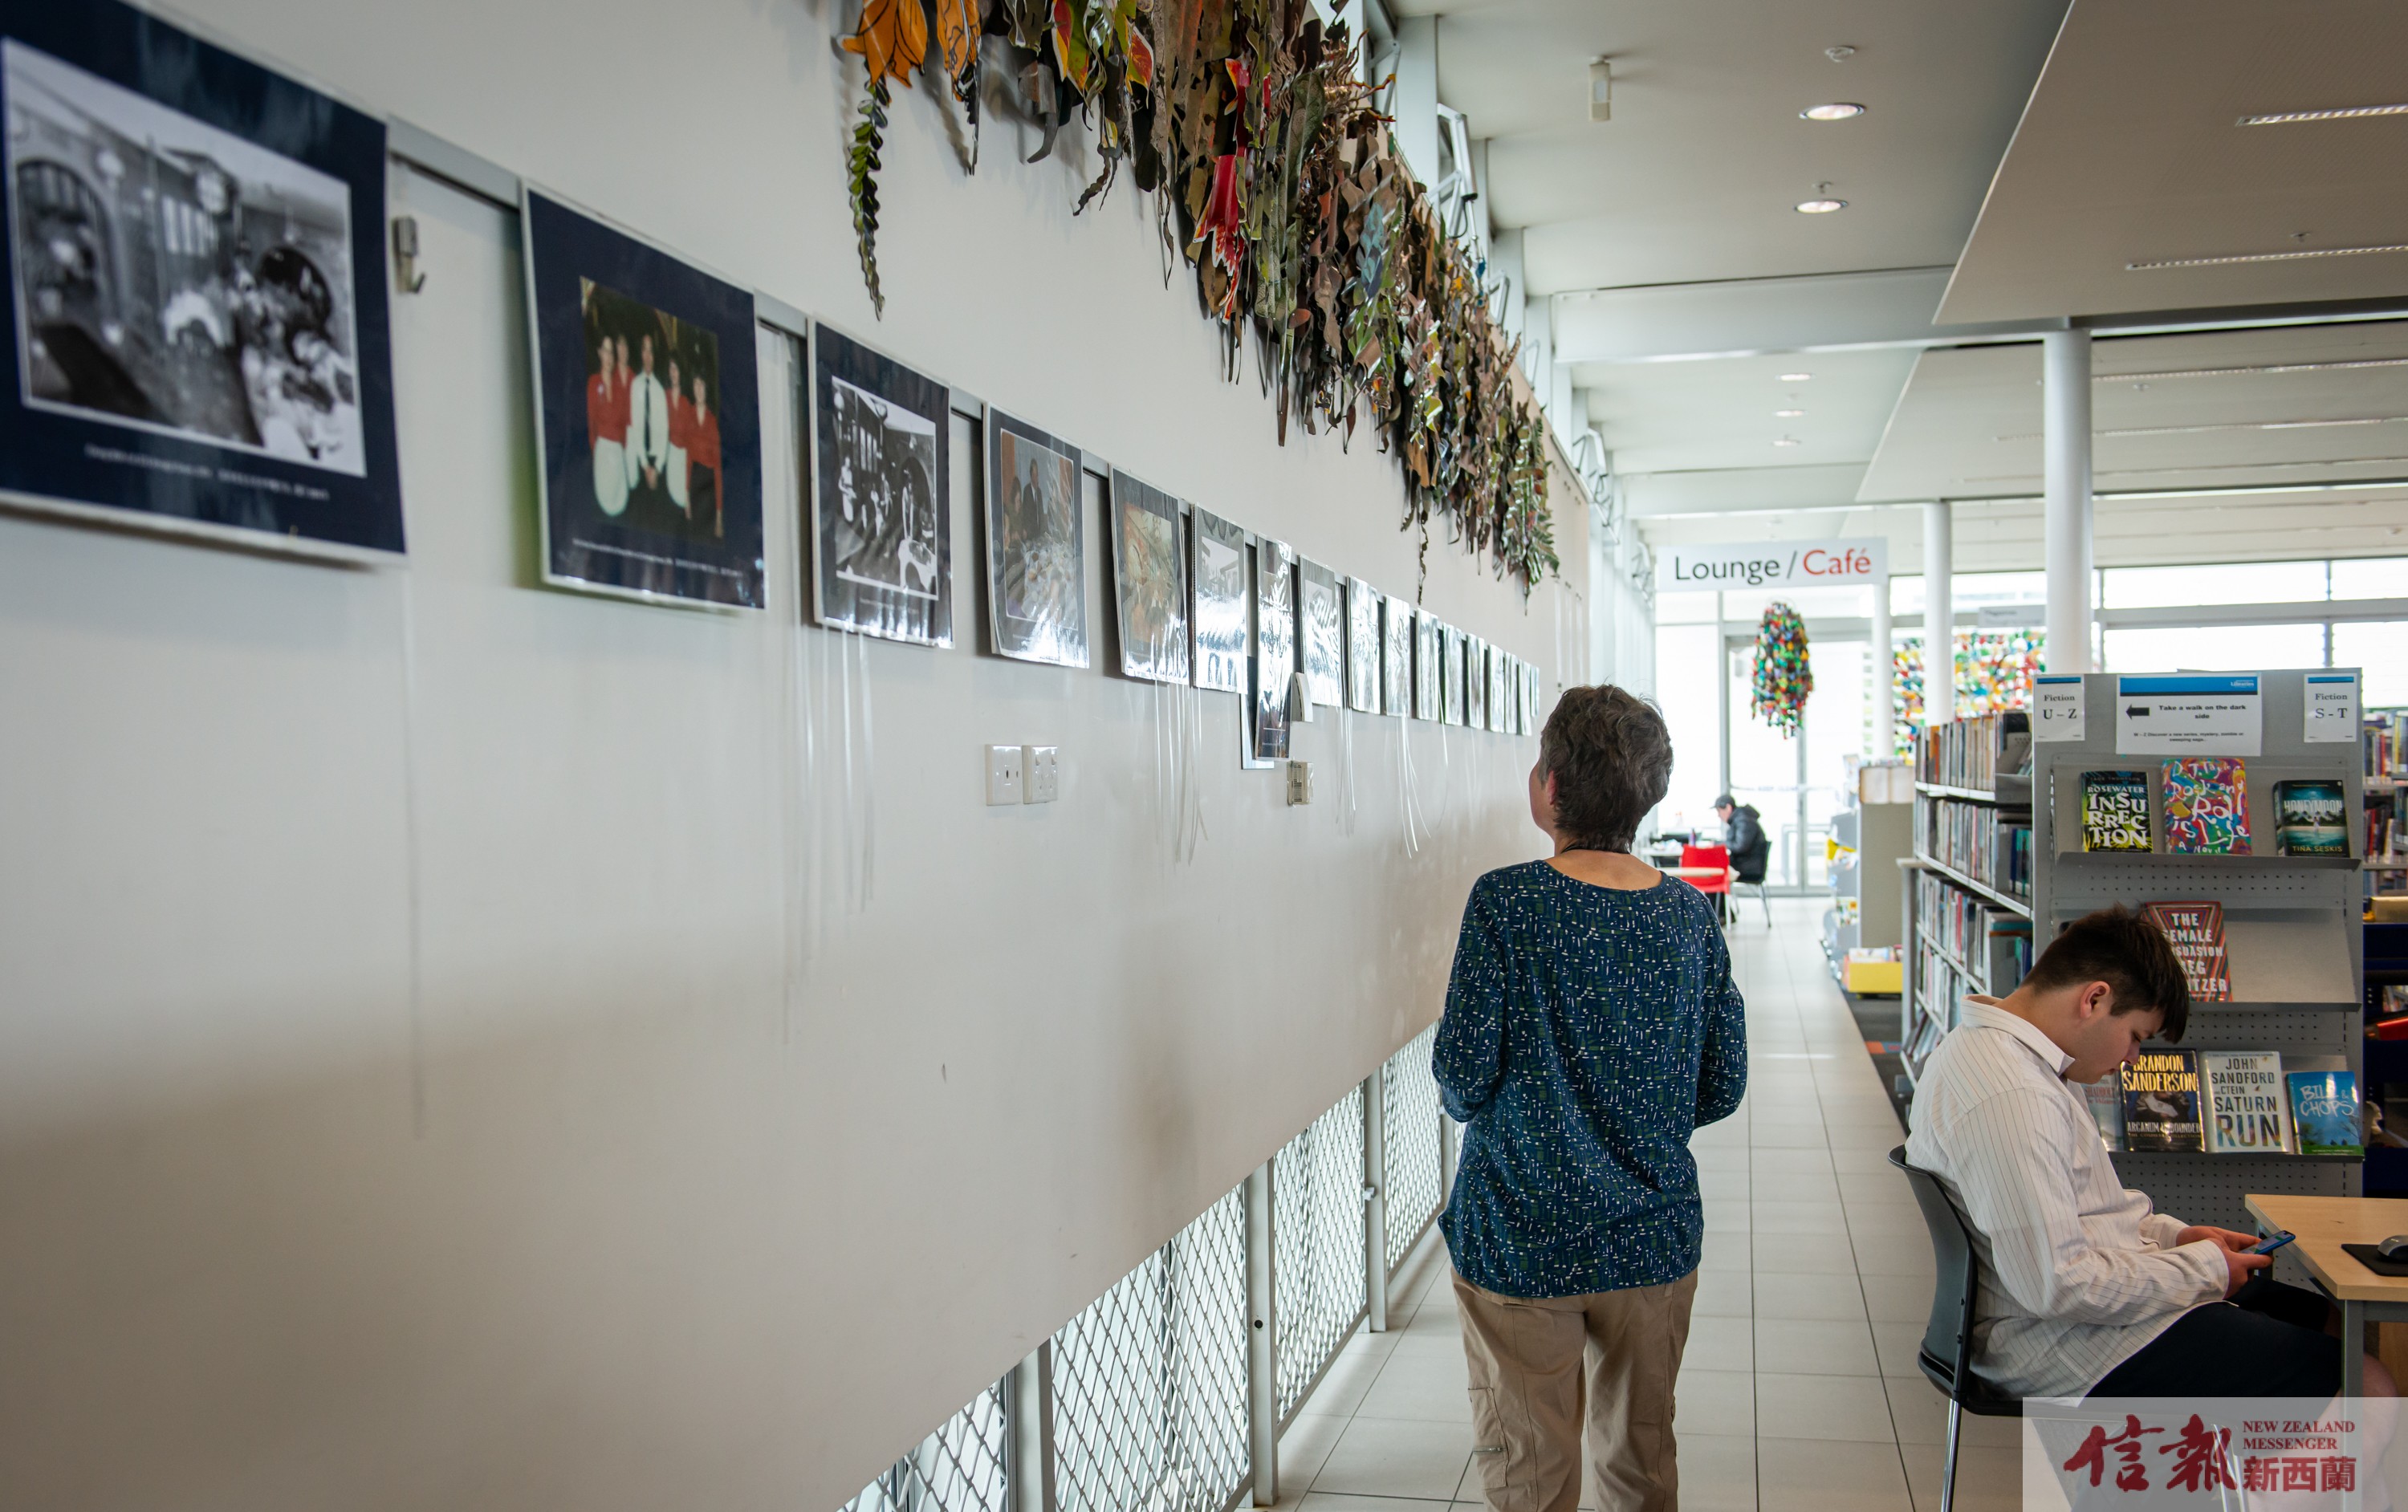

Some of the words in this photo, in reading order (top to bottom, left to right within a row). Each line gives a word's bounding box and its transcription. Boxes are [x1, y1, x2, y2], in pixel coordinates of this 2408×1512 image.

[1675, 556, 1780, 585] Lounge
[1803, 547, 1872, 575] Café
[2043, 709, 2052, 720] U
[2068, 709, 2077, 719] Z
[2315, 708, 2325, 719] S
[2337, 708, 2348, 718] T
[2087, 785, 2146, 794] ROSEWATER
[2168, 781, 2215, 803] Rock
[2219, 779, 2245, 795] and
[2089, 792, 2147, 814] INSU
[2191, 791, 2243, 825] Roll
[2284, 799, 2343, 813] HONEYMOON
[2089, 811, 2148, 830] RREC
[2089, 827, 2149, 847] TION
[2172, 815, 2197, 839] is
[2197, 818, 2250, 851] Life
[2170, 912, 2200, 926] THE
[2172, 946, 2223, 957] SUASION
[2225, 1059, 2259, 1070] JOHN
[2123, 1070, 2198, 1091] SANDERSON
[2211, 1071, 2275, 1084] SANDFORD
[2220, 1086, 2245, 1095] CTEIN
[2215, 1096, 2278, 1112] SATURN
[2300, 1099, 2354, 1117] CHOPS
[2127, 1121, 2159, 1132] ARCANUM
[2216, 1114, 2282, 1148] RUN
